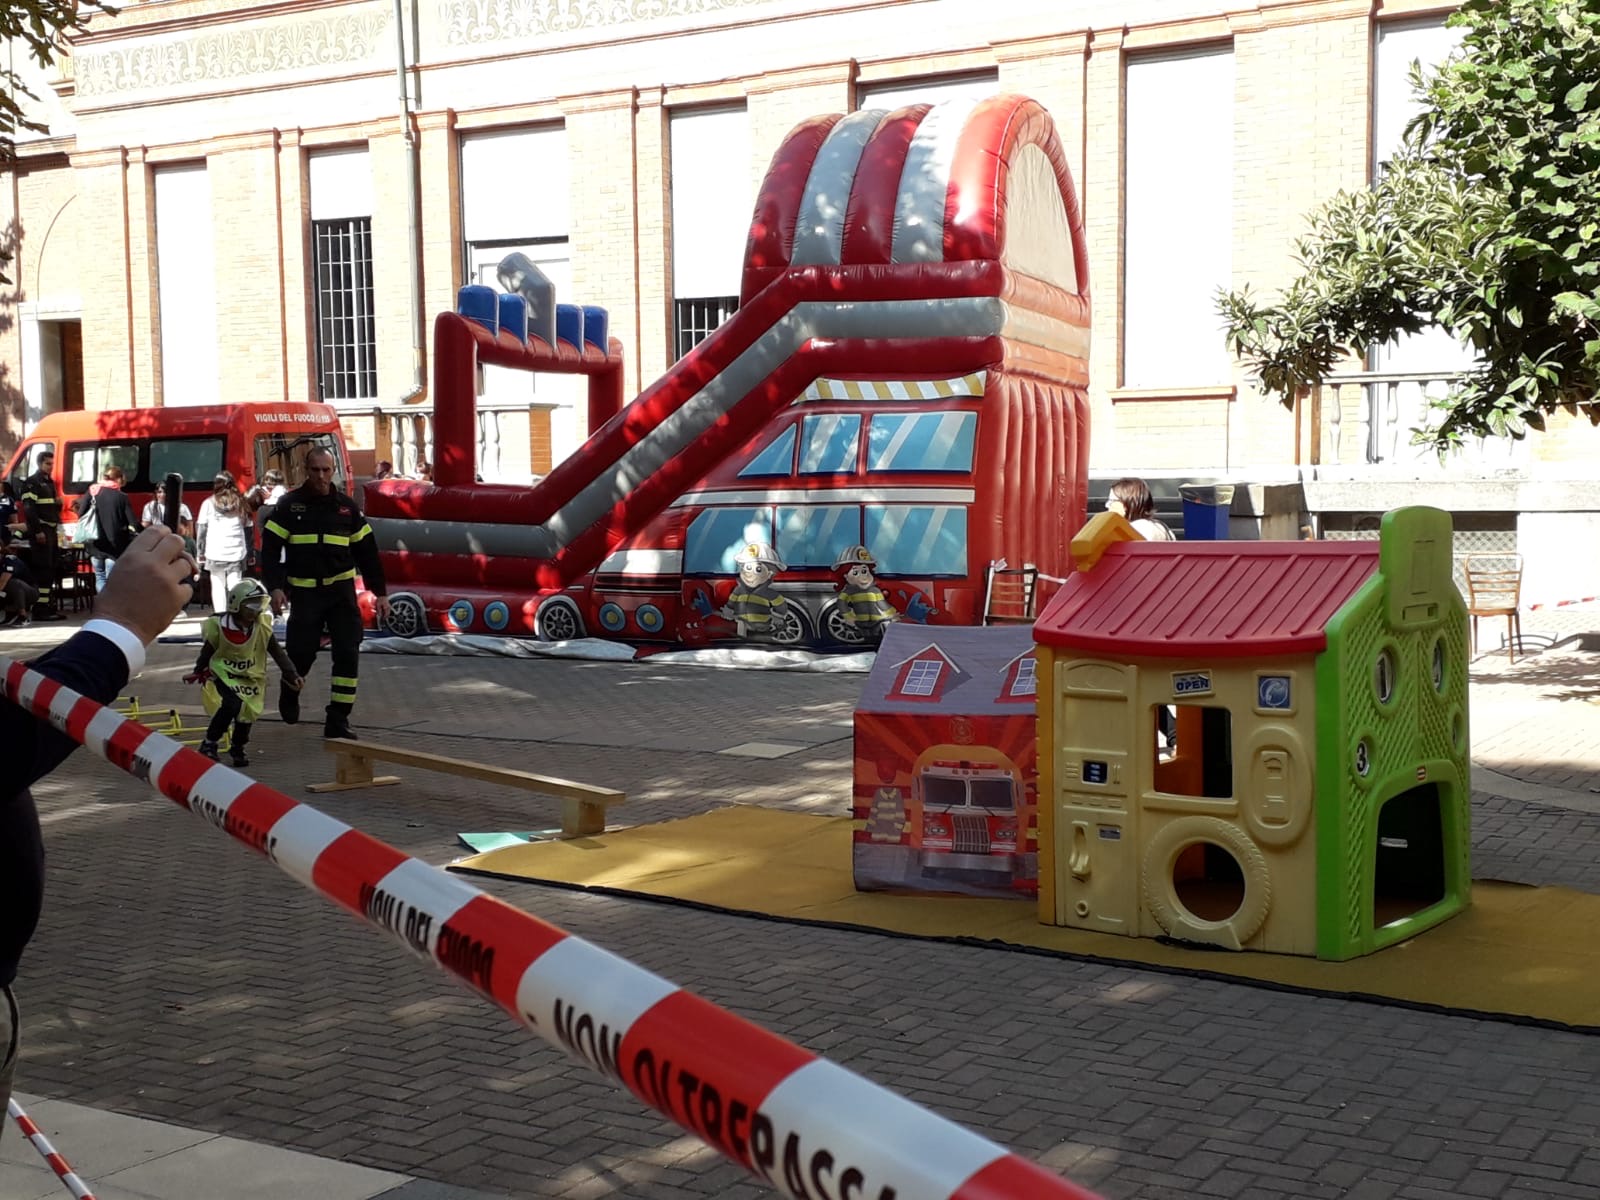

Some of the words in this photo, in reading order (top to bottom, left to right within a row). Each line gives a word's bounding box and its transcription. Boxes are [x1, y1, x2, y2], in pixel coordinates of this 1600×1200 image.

[255, 413, 277, 422] VIGILI
[279, 414, 291, 422] DEL
[294, 414, 315, 422] FUOCO
[1175, 678, 1209, 691] OPEN
[1356, 742, 1368, 773] 3
